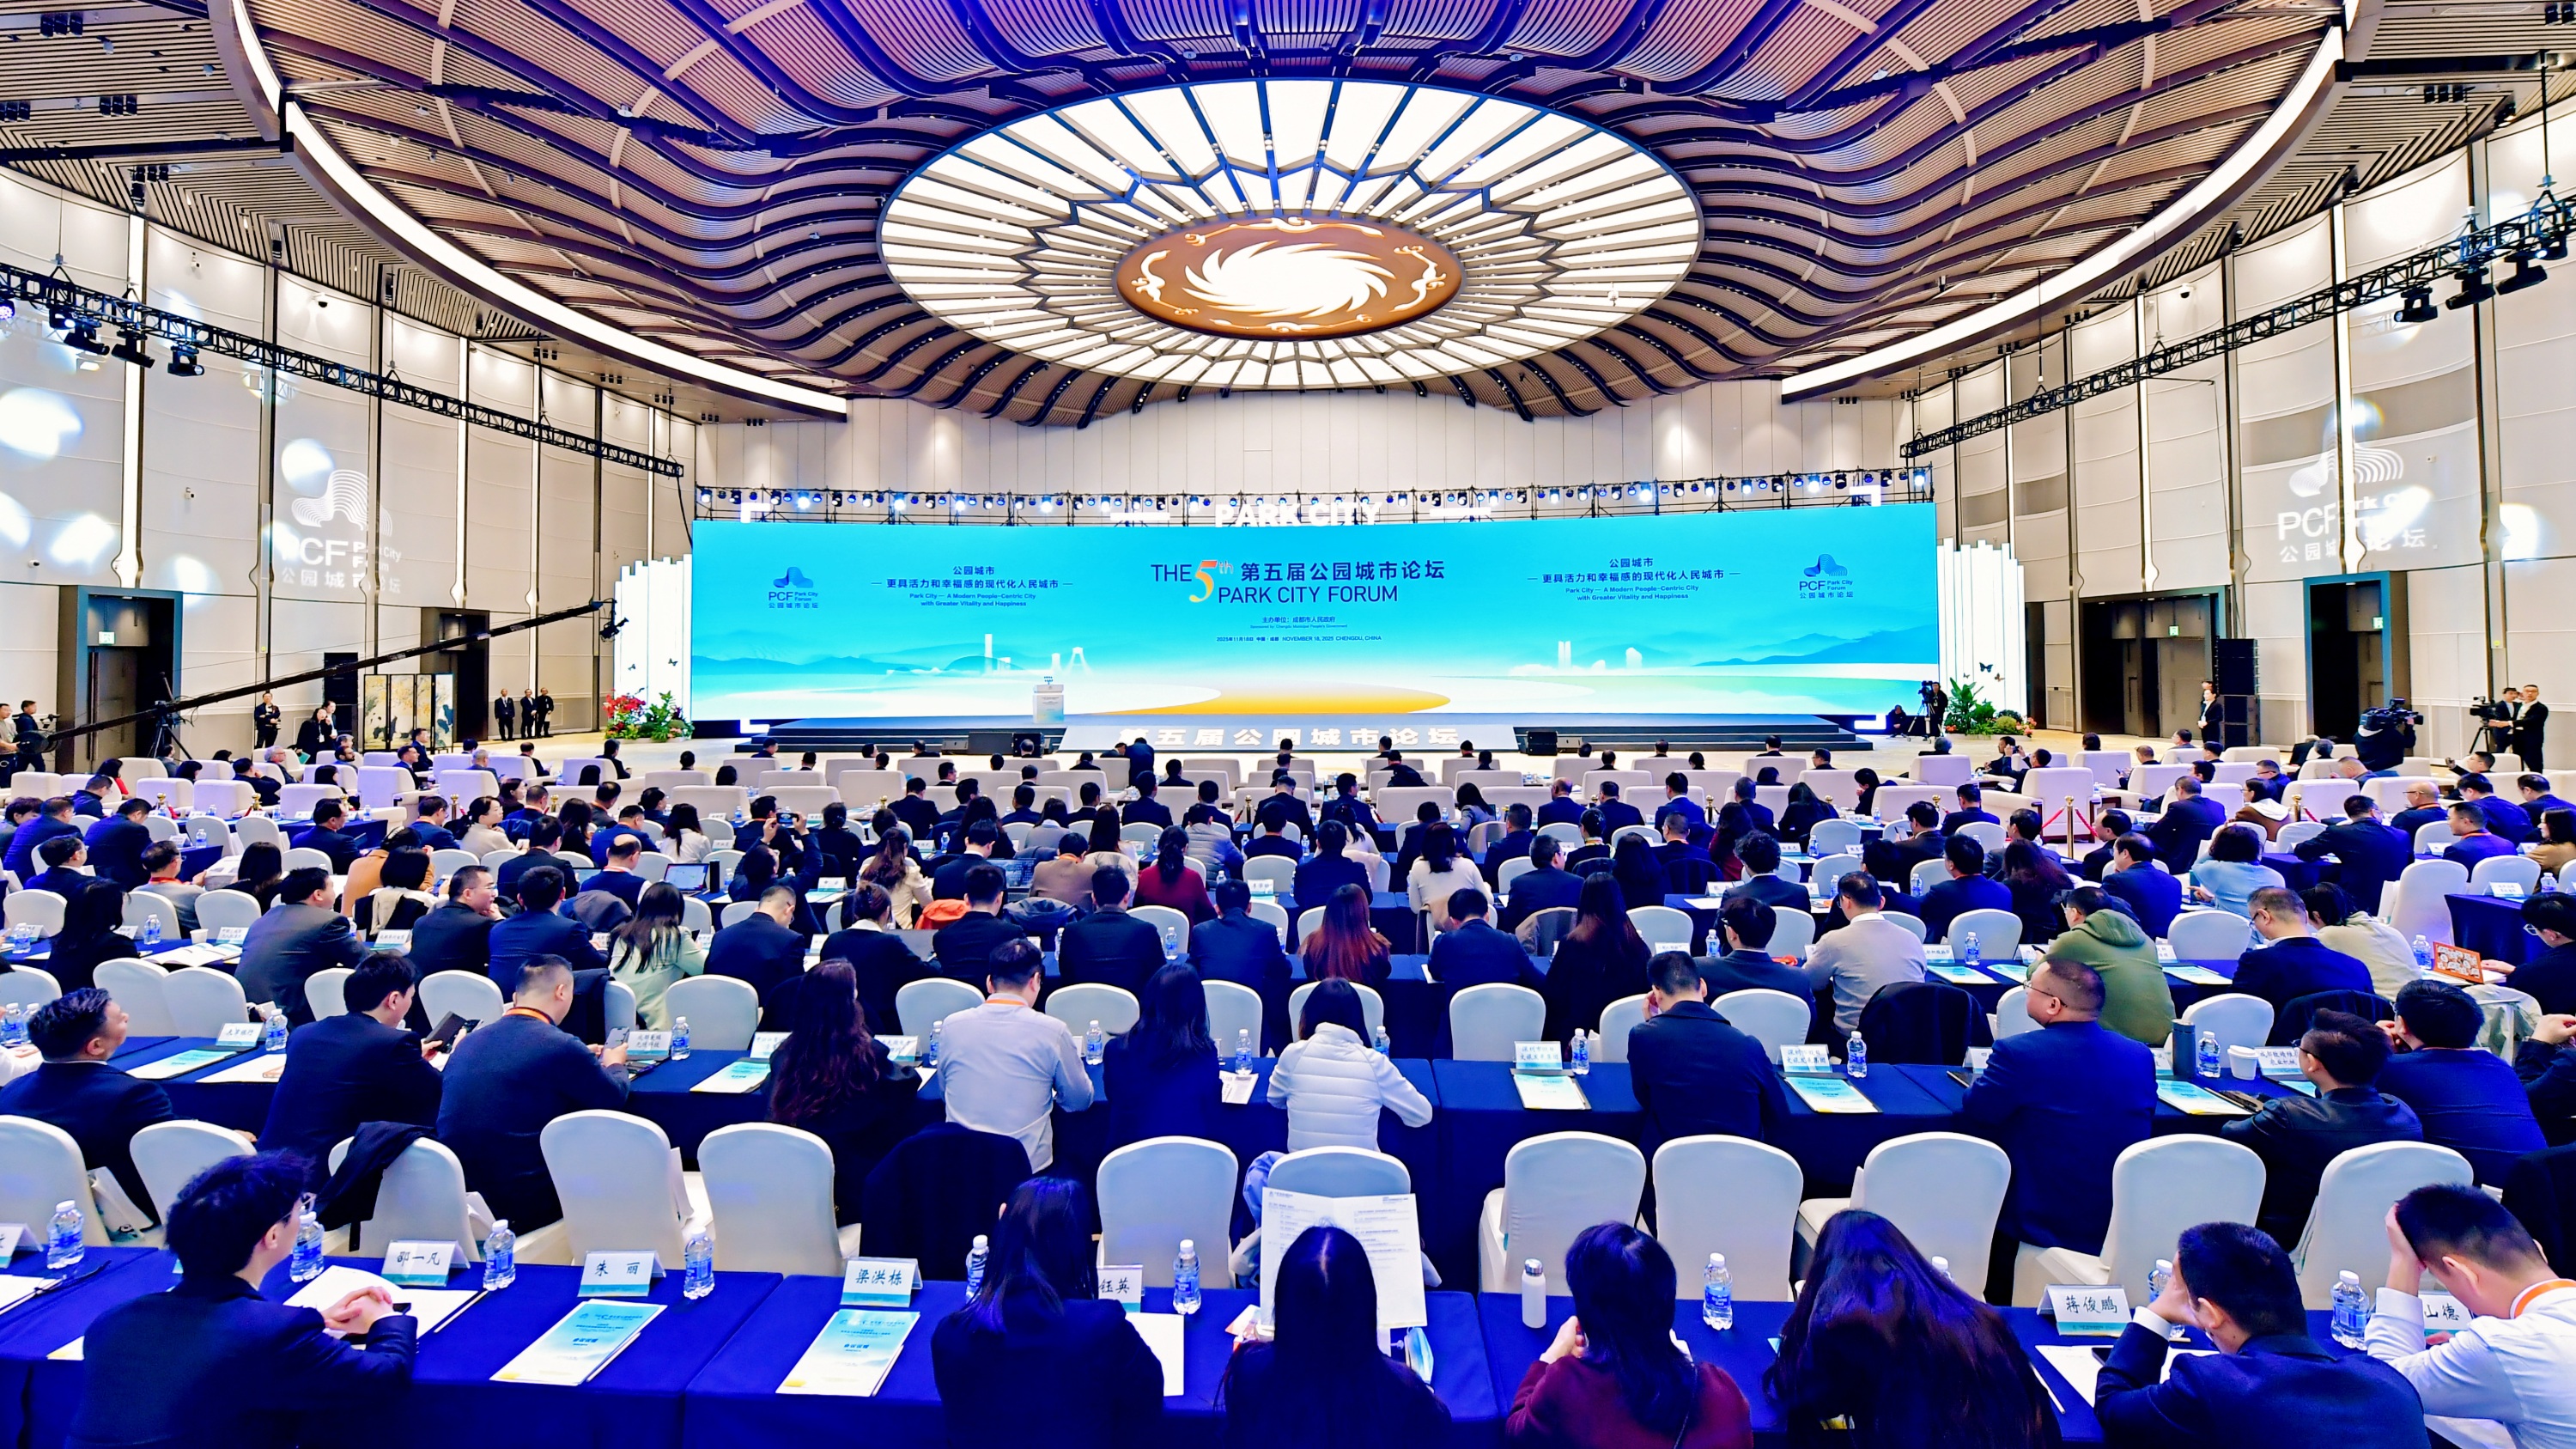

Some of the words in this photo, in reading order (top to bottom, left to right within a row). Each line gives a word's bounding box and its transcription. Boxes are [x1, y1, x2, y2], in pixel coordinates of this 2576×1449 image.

[1215, 502, 1301, 527] PARK
[1309, 501, 1382, 527] CITY
[2278, 503, 2336, 540] PCF
[2280, 528, 2426, 563] 公园城坛
[953, 565, 995, 575] 公园城市
[1242, 560, 1445, 582] 第五届公园城市论坛
[1609, 557, 1654, 568] 公园城市
[1151, 563, 1193, 582] THE
[1542, 569, 1725, 584] 更具活力和幸福感的现代化人民城市
[887, 578, 1059, 589] 更具活力和幸福感的现代化人民城市
[1799, 581, 1826, 591] PCF
[769, 591, 793, 601] PCF
[1218, 587, 1273, 604] PARK
[1278, 586, 1321, 603] CITY
[1328, 585, 1398, 602] FORUM
[397, 1251, 440, 1268] 邵一凡
[595, 1260, 641, 1277] 朱丽
[1099, 1277, 1130, 1294] 钰英
[2065, 1295, 2118, 1314] 蒋俊鹏
[2423, 1303, 2460, 1321] 山德
